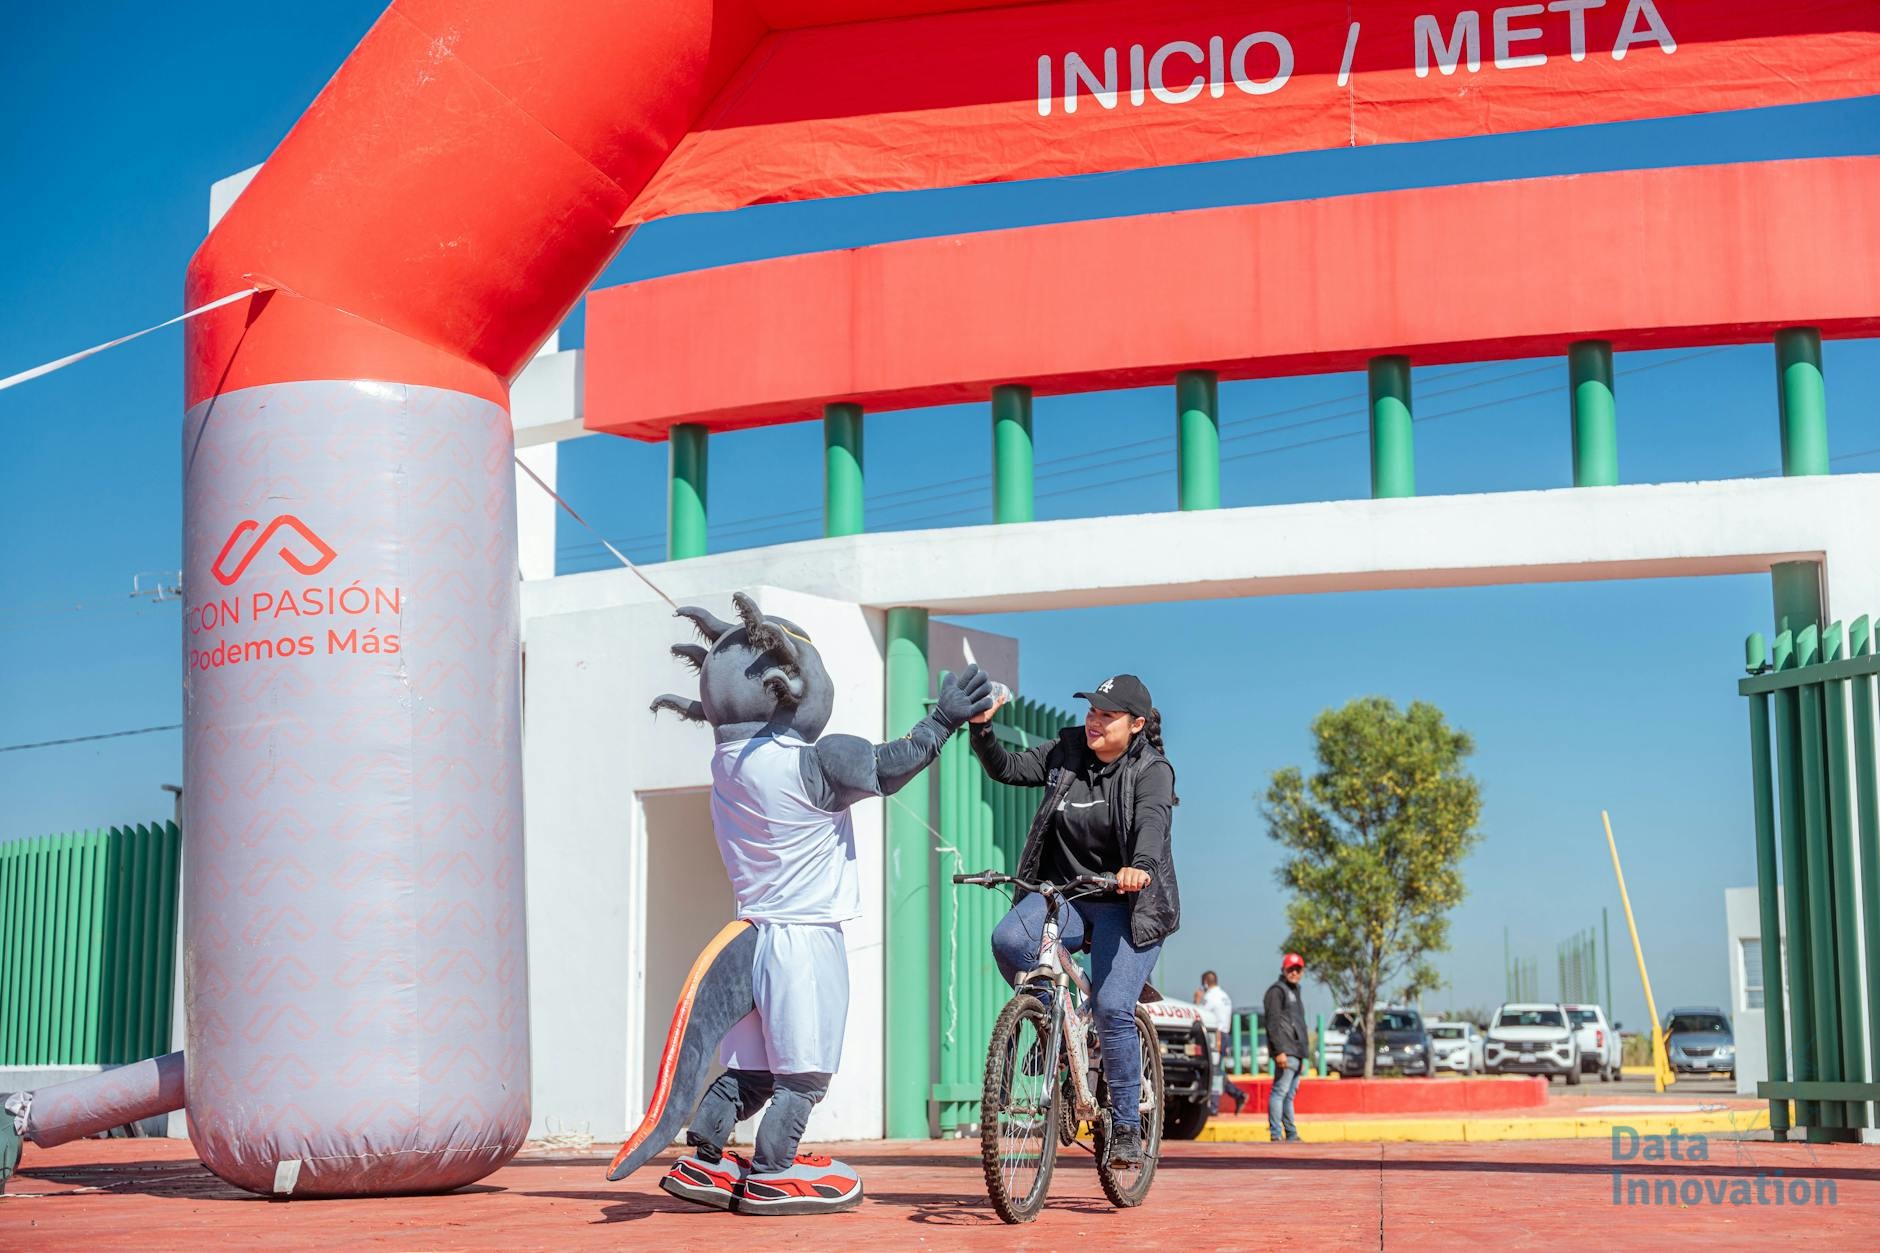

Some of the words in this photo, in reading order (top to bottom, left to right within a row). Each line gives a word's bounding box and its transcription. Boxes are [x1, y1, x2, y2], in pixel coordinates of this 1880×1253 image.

[1037, 31, 1295, 117] INICIO
[1337, 22, 1361, 88] /
[1414, 0, 1678, 78] META
[190, 596, 239, 635] CON
[253, 580, 400, 621] PASIÓN
[190, 635, 315, 671] Podemos
[327, 627, 400, 655] Más
